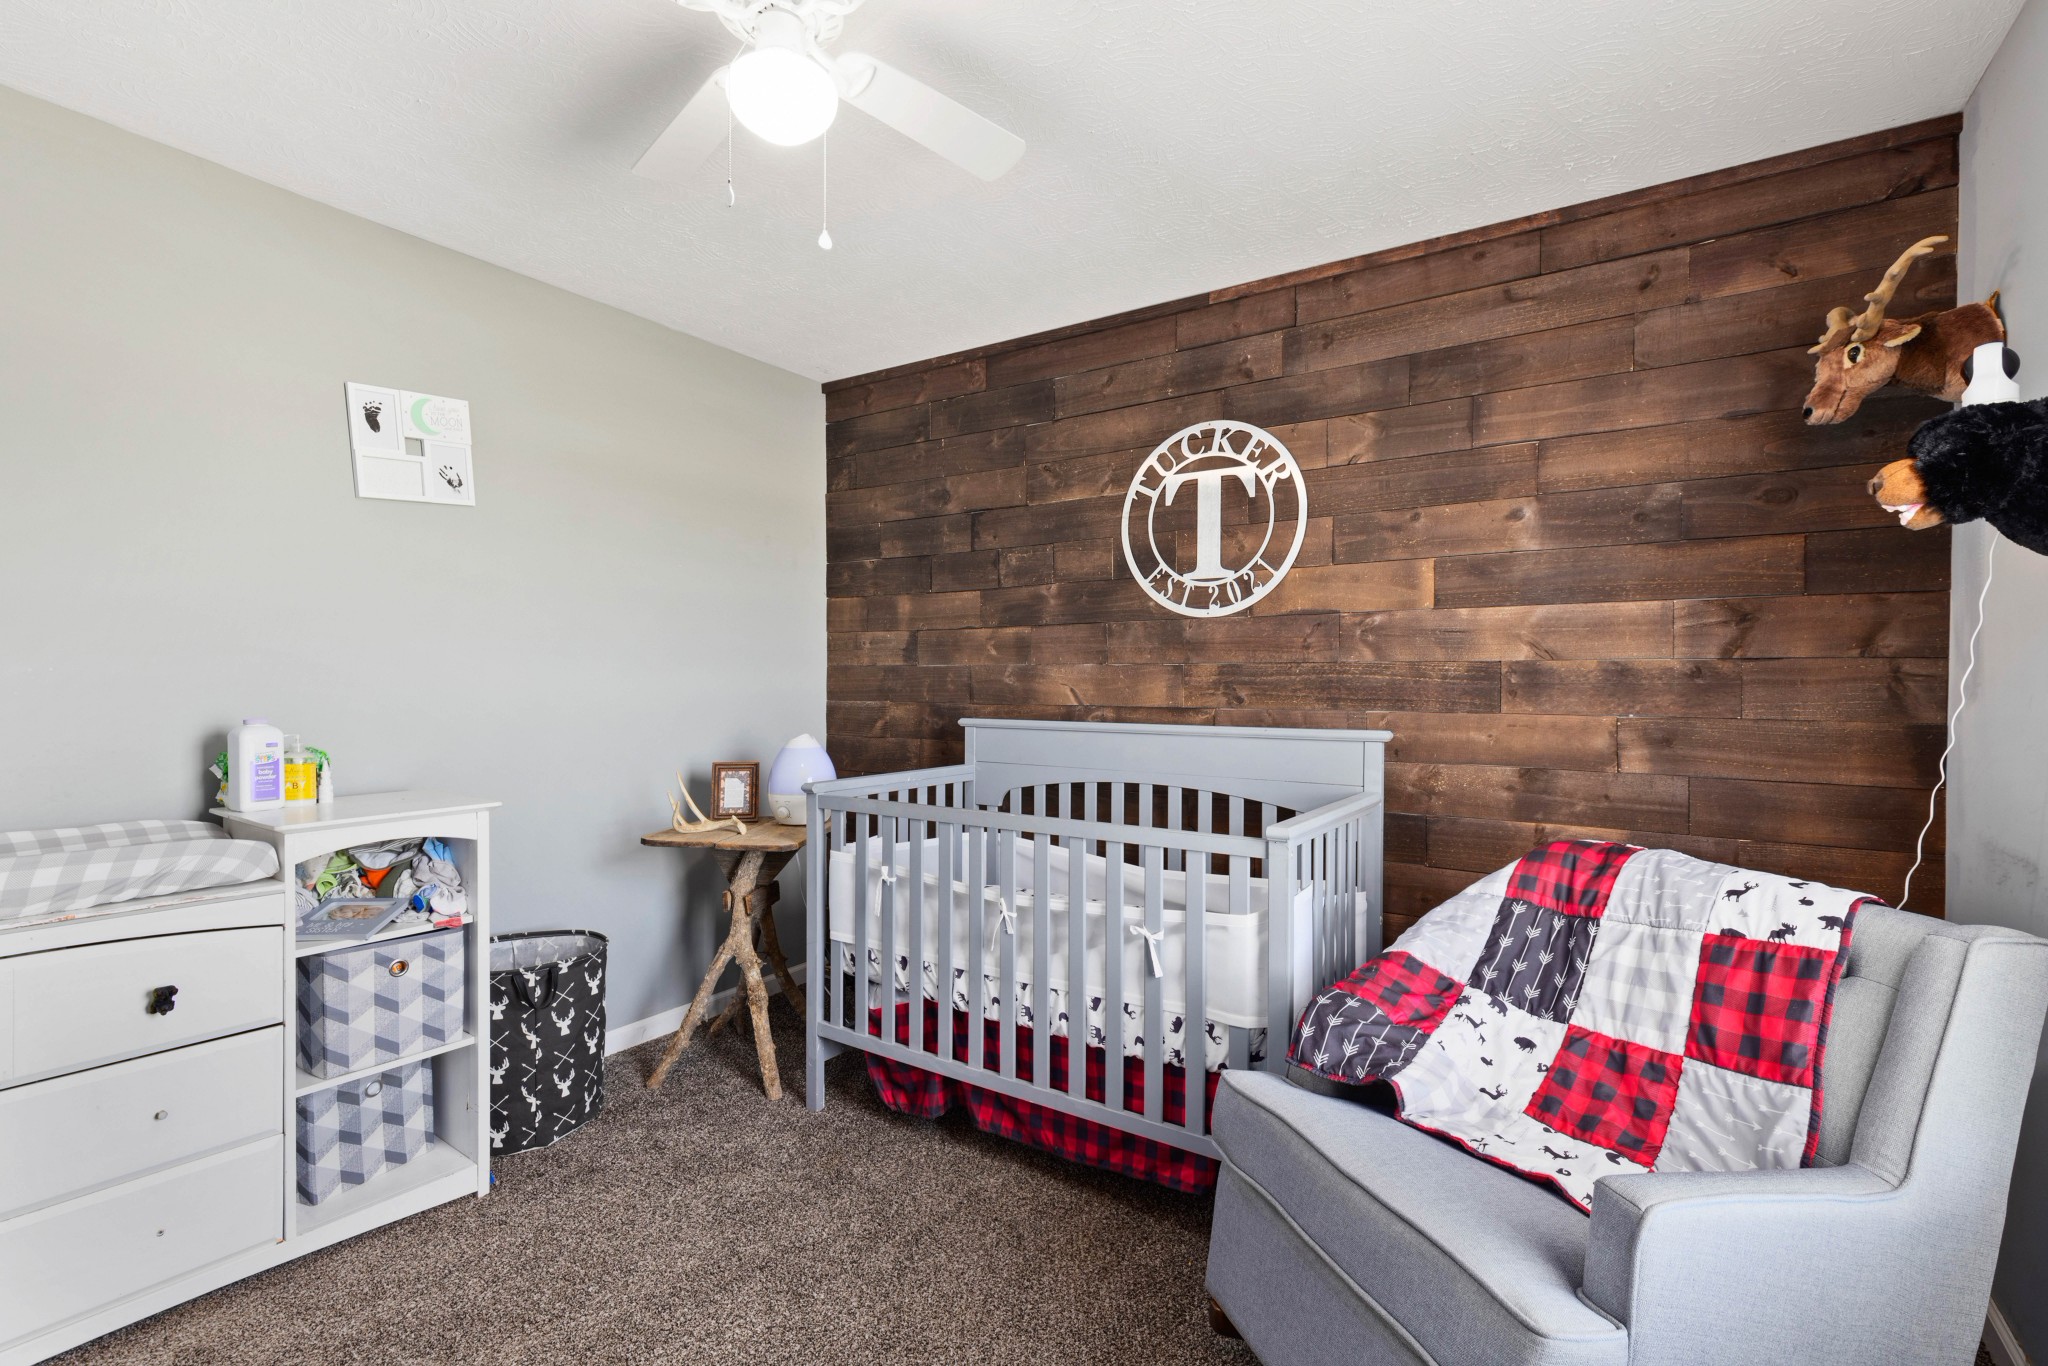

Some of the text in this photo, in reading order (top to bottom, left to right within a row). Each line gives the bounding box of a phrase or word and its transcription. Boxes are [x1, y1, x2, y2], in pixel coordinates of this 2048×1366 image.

[1132, 427, 1291, 499] TUCKER
[1165, 465, 1256, 579] T
[1145, 558, 1279, 609] EST 2021
